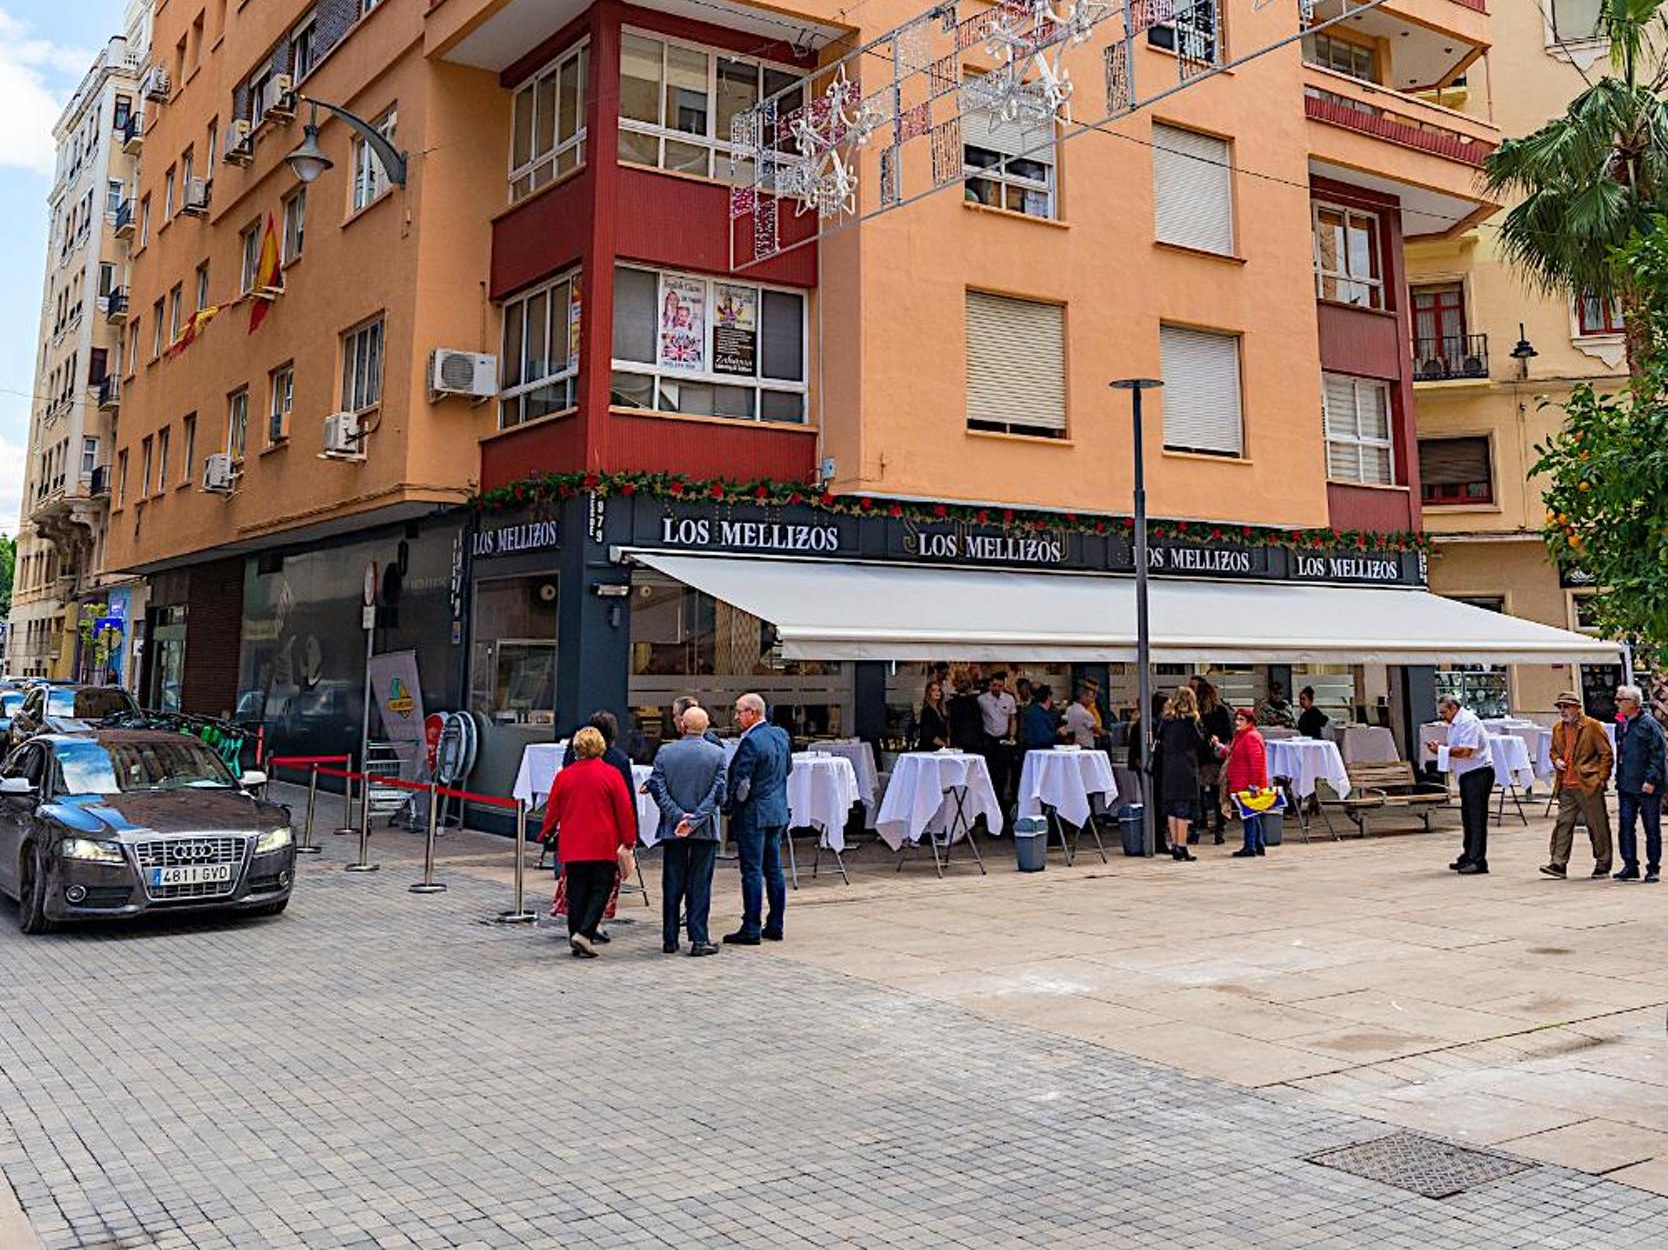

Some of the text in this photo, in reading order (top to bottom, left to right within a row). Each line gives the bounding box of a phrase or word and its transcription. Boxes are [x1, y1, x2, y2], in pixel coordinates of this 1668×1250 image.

[596, 500, 604, 543] 979
[663, 517, 838, 551] LOS MELLIZOS
[472, 520, 557, 555] LOS MELLIZOS
[919, 533, 1061, 562] LOS MELLIZOS
[1170, 549, 1250, 572] MELLIZOS
[1297, 556, 1398, 580] LOS MELLIZOS
[163, 866, 228, 883] 4811 GVD
